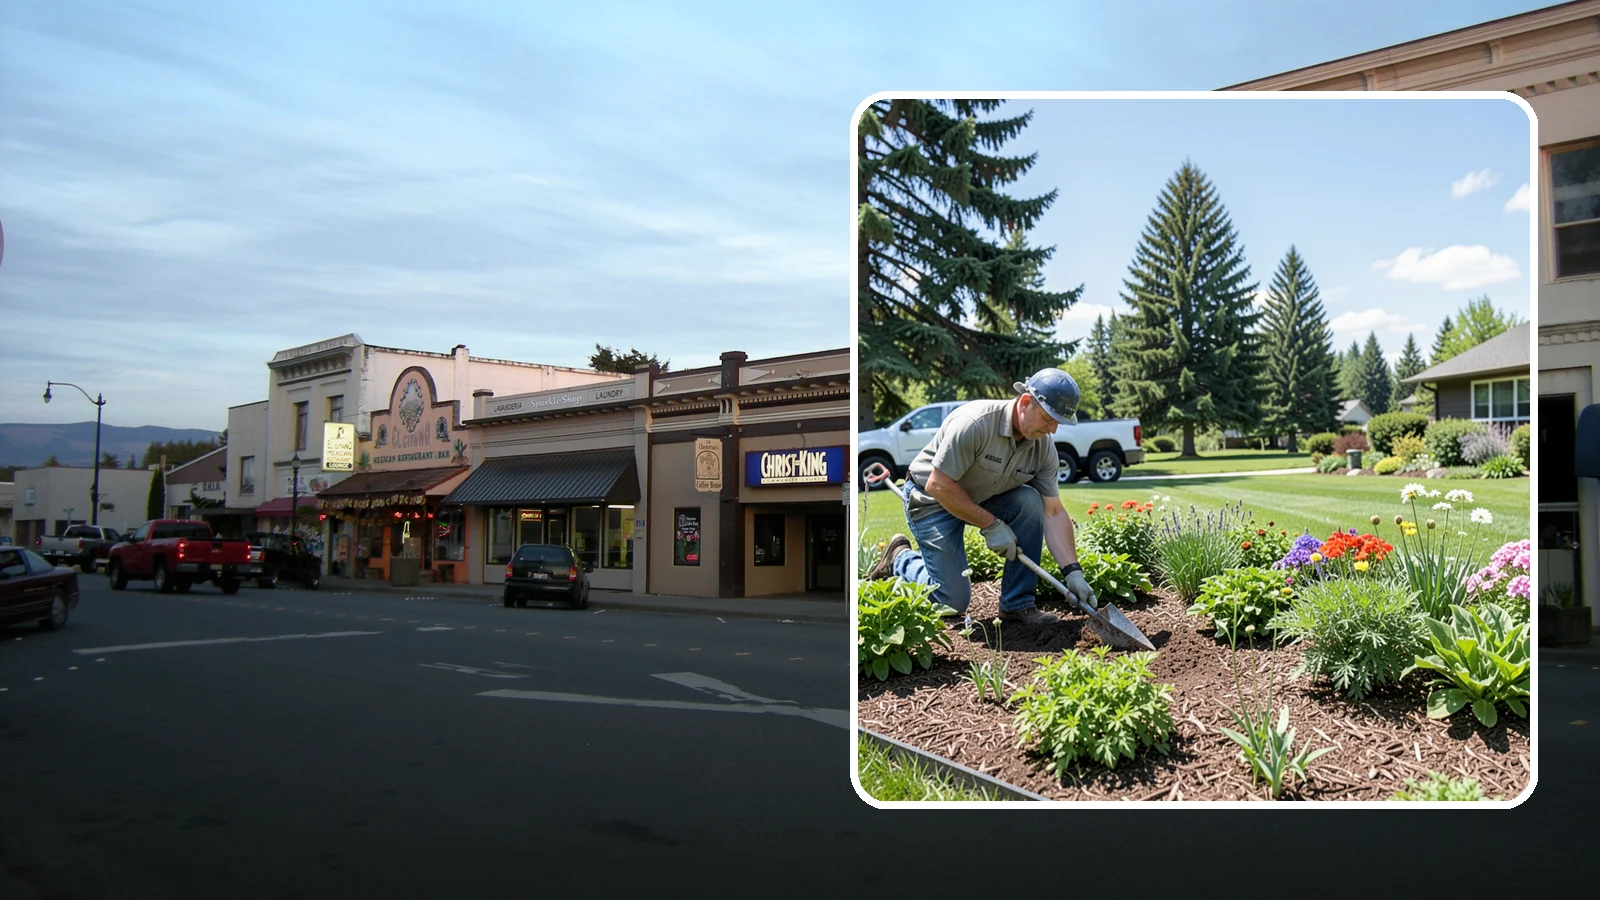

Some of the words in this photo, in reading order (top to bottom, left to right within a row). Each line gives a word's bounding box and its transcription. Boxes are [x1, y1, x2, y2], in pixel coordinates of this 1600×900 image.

[493, 402, 522, 413] LAVANDERIA
[531, 397, 560, 408] Sparkle
[562, 394, 582, 405] Shop
[595, 389, 624, 400] LAUNDRY
[373, 454, 396, 464] MEXICAN
[397, 451, 433, 463] RESTAURANT
[437, 450, 450, 459] BAR
[761, 452, 797, 477] CHRIST
[799, 450, 827, 476] KING
[696, 480, 709, 489] Coffee
[710, 480, 722, 489] House
